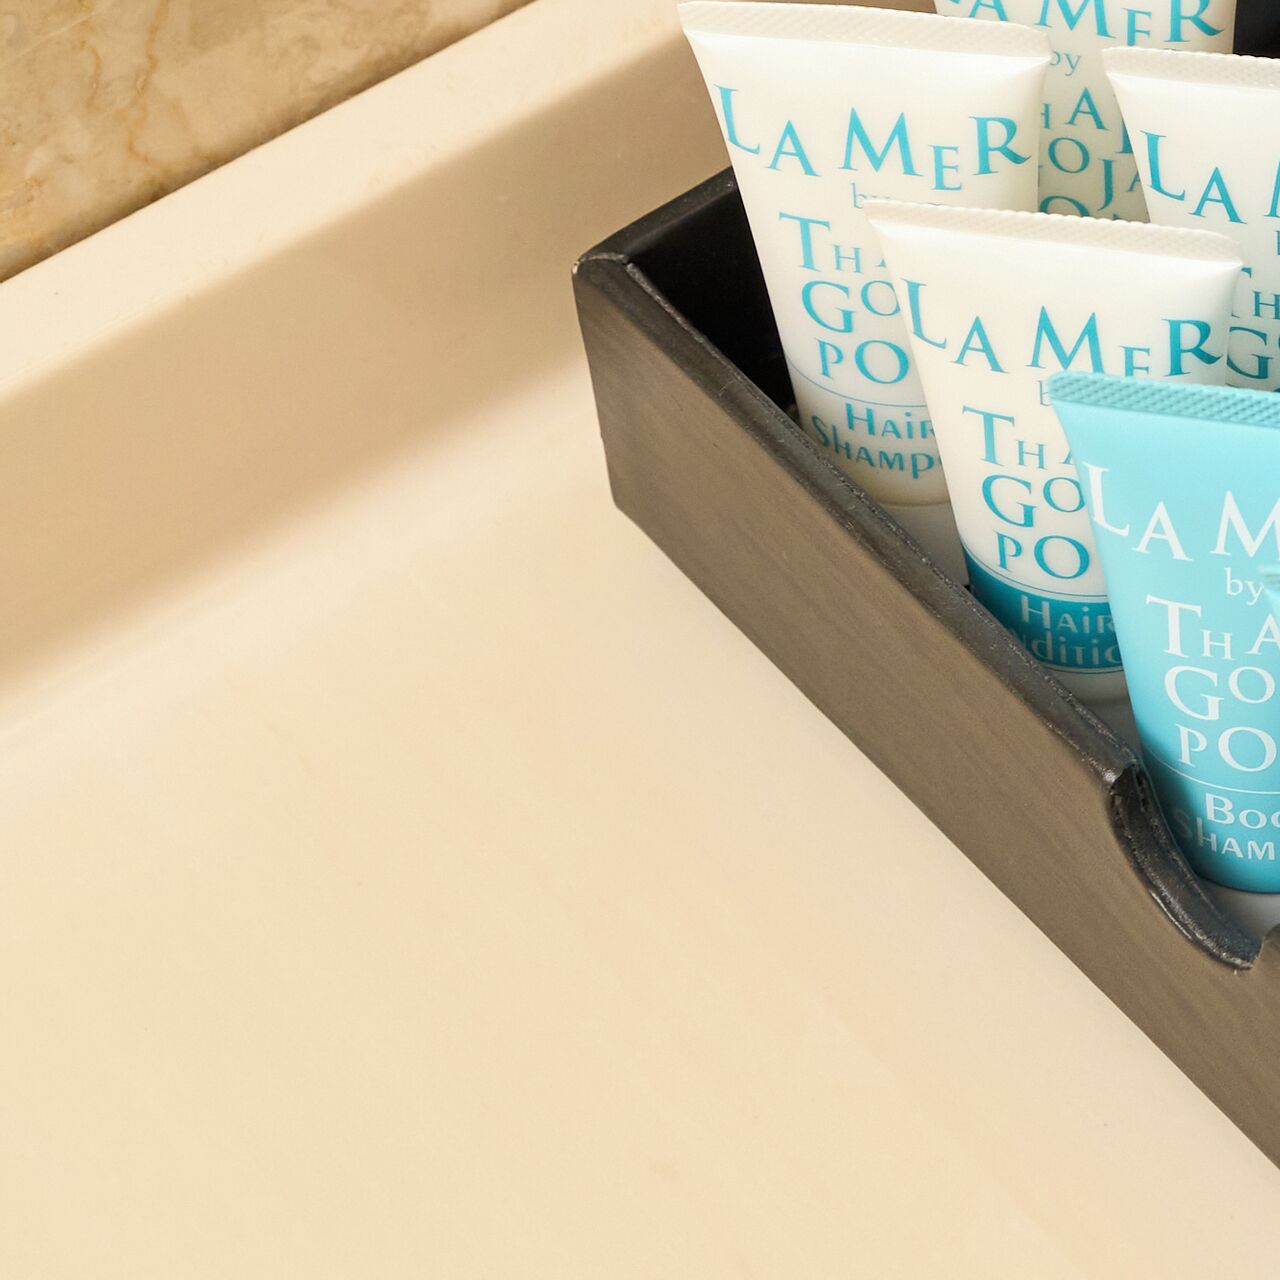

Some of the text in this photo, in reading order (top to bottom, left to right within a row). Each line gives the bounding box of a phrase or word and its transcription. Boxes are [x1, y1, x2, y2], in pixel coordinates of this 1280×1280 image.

[713, 82, 822, 178] LA
[838, 106, 1034, 193] MER
[851, 181, 882, 210] b
[1139, 129, 1248, 225] LA
[800, 279, 902, 335] GO
[900, 276, 1010, 375] LA
[816, 336, 911, 386] PO
[1082, 460, 1194, 562] LA
[993, 529, 1091, 581] PO
[1224, 567, 1264, 606] by
